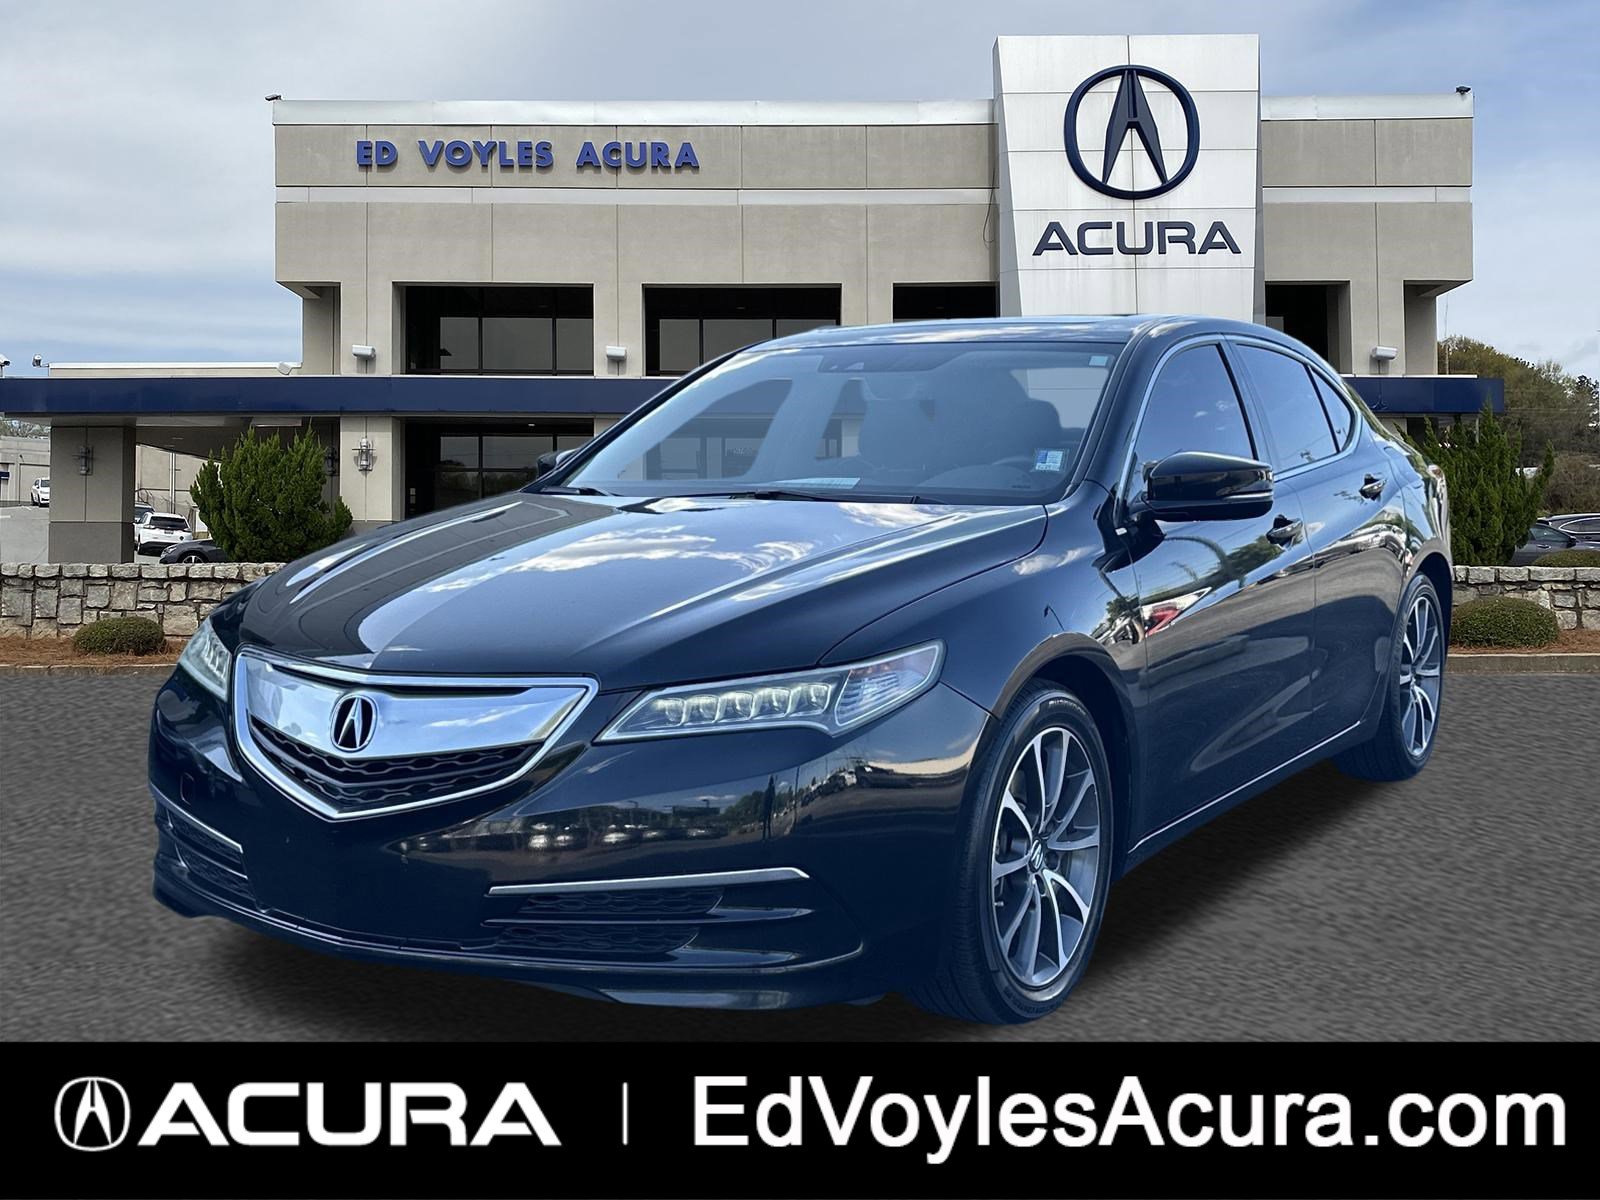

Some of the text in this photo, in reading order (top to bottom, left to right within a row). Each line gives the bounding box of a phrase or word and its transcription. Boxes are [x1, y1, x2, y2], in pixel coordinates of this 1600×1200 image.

[356, 140, 700, 169] ED VOYLES ACURA
[1032, 221, 1242, 256] ACURA
